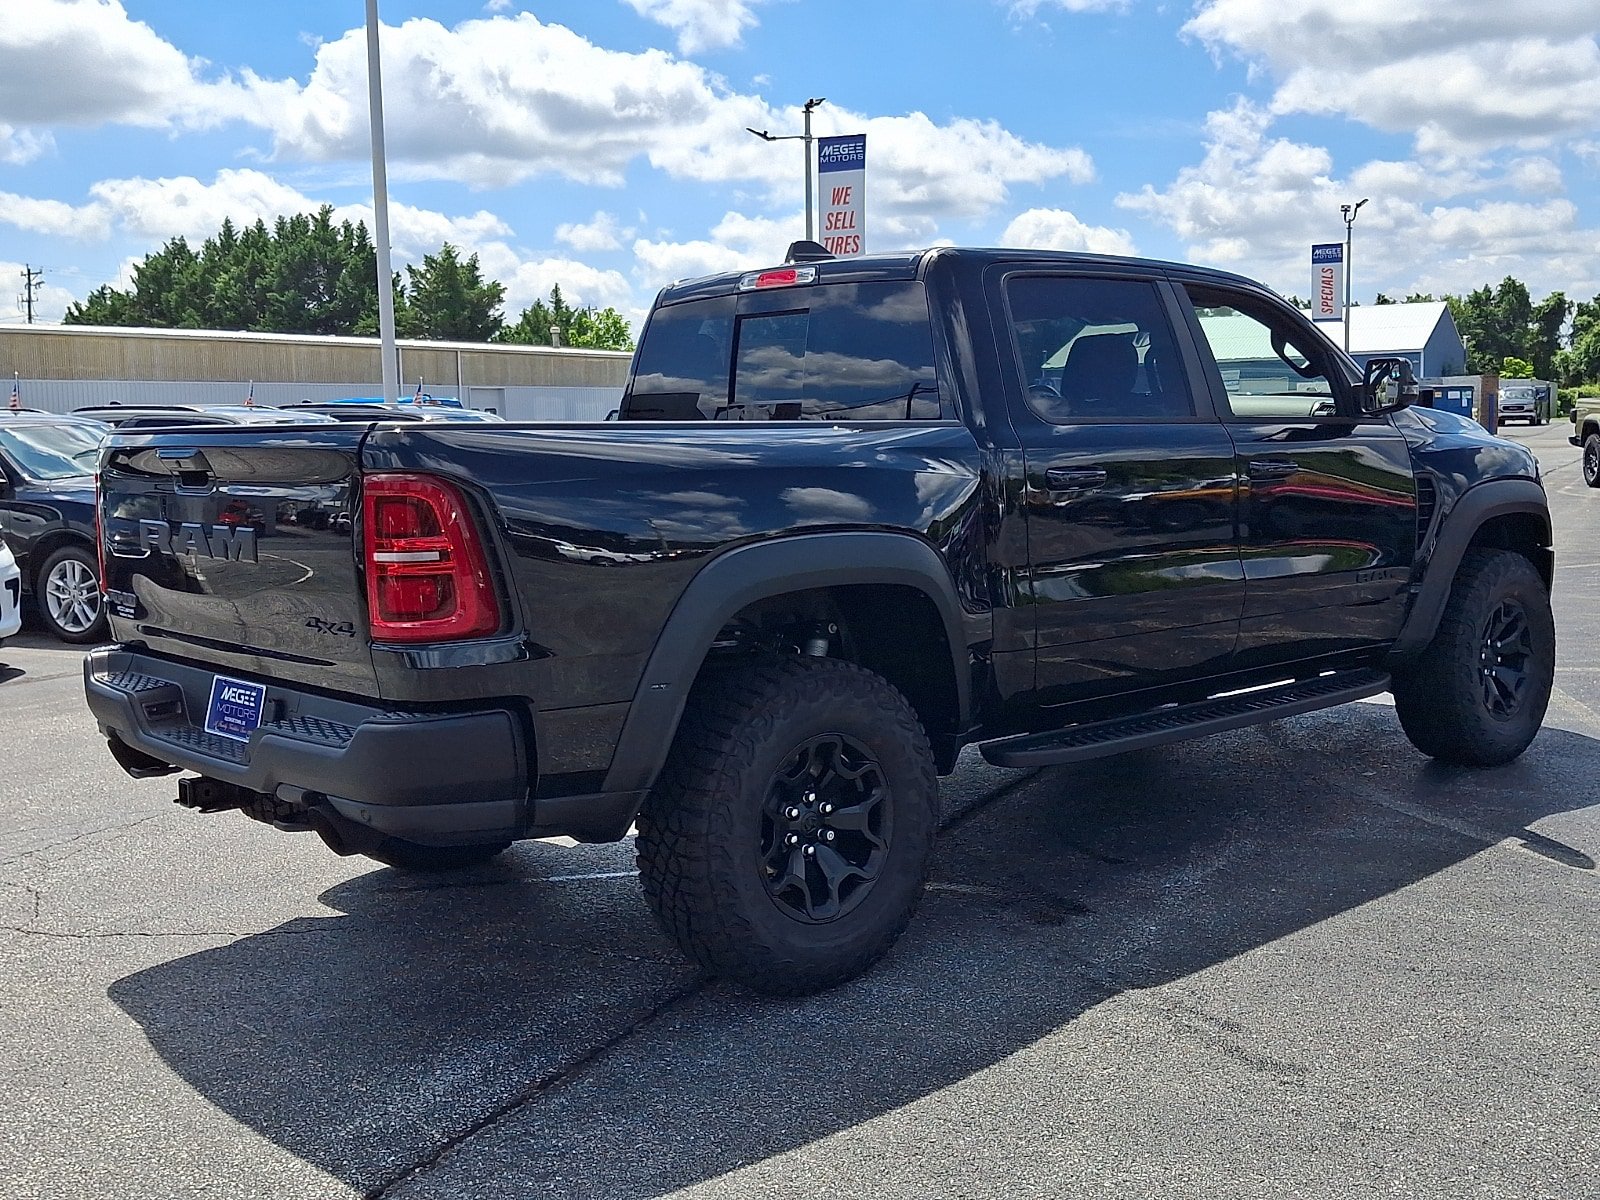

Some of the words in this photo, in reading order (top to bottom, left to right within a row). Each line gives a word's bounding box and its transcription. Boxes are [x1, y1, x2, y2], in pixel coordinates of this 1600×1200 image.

[820, 143, 864, 157] MEGEE
[820, 153, 864, 164] MOTORS
[831, 186, 852, 206] WE
[825, 210, 856, 231] SELL
[823, 234, 860, 255] TIRES
[1313, 247, 1342, 255] MEGEE
[1321, 267, 1334, 314] SPECIALS
[139, 519, 259, 563] RAM
[220, 686, 257, 707] MEGEE
[216, 702, 256, 721] MOTORS
